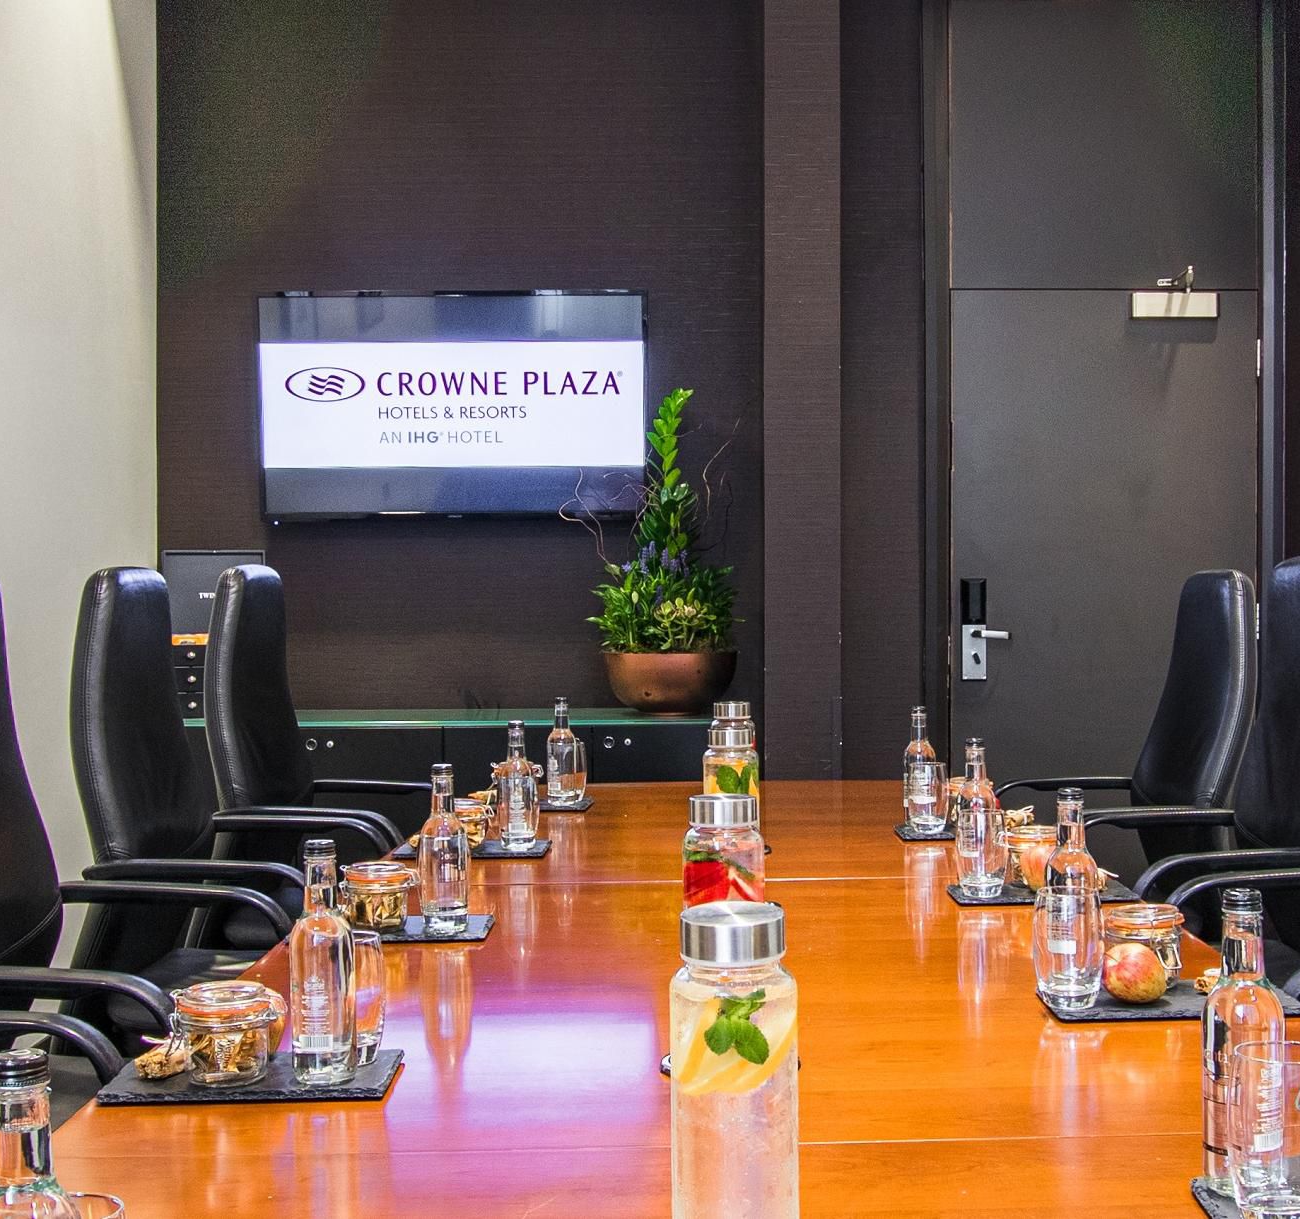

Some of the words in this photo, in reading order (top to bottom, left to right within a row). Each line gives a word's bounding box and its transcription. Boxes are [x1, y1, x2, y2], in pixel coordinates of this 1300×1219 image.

[377, 371, 508, 396] CROWNE
[378, 406, 438, 420] HOTELS
[443, 406, 454, 419] &
[459, 405, 527, 419] RESORTS
[379, 430, 402, 444] AN
[447, 430, 503, 443] HOTEL
